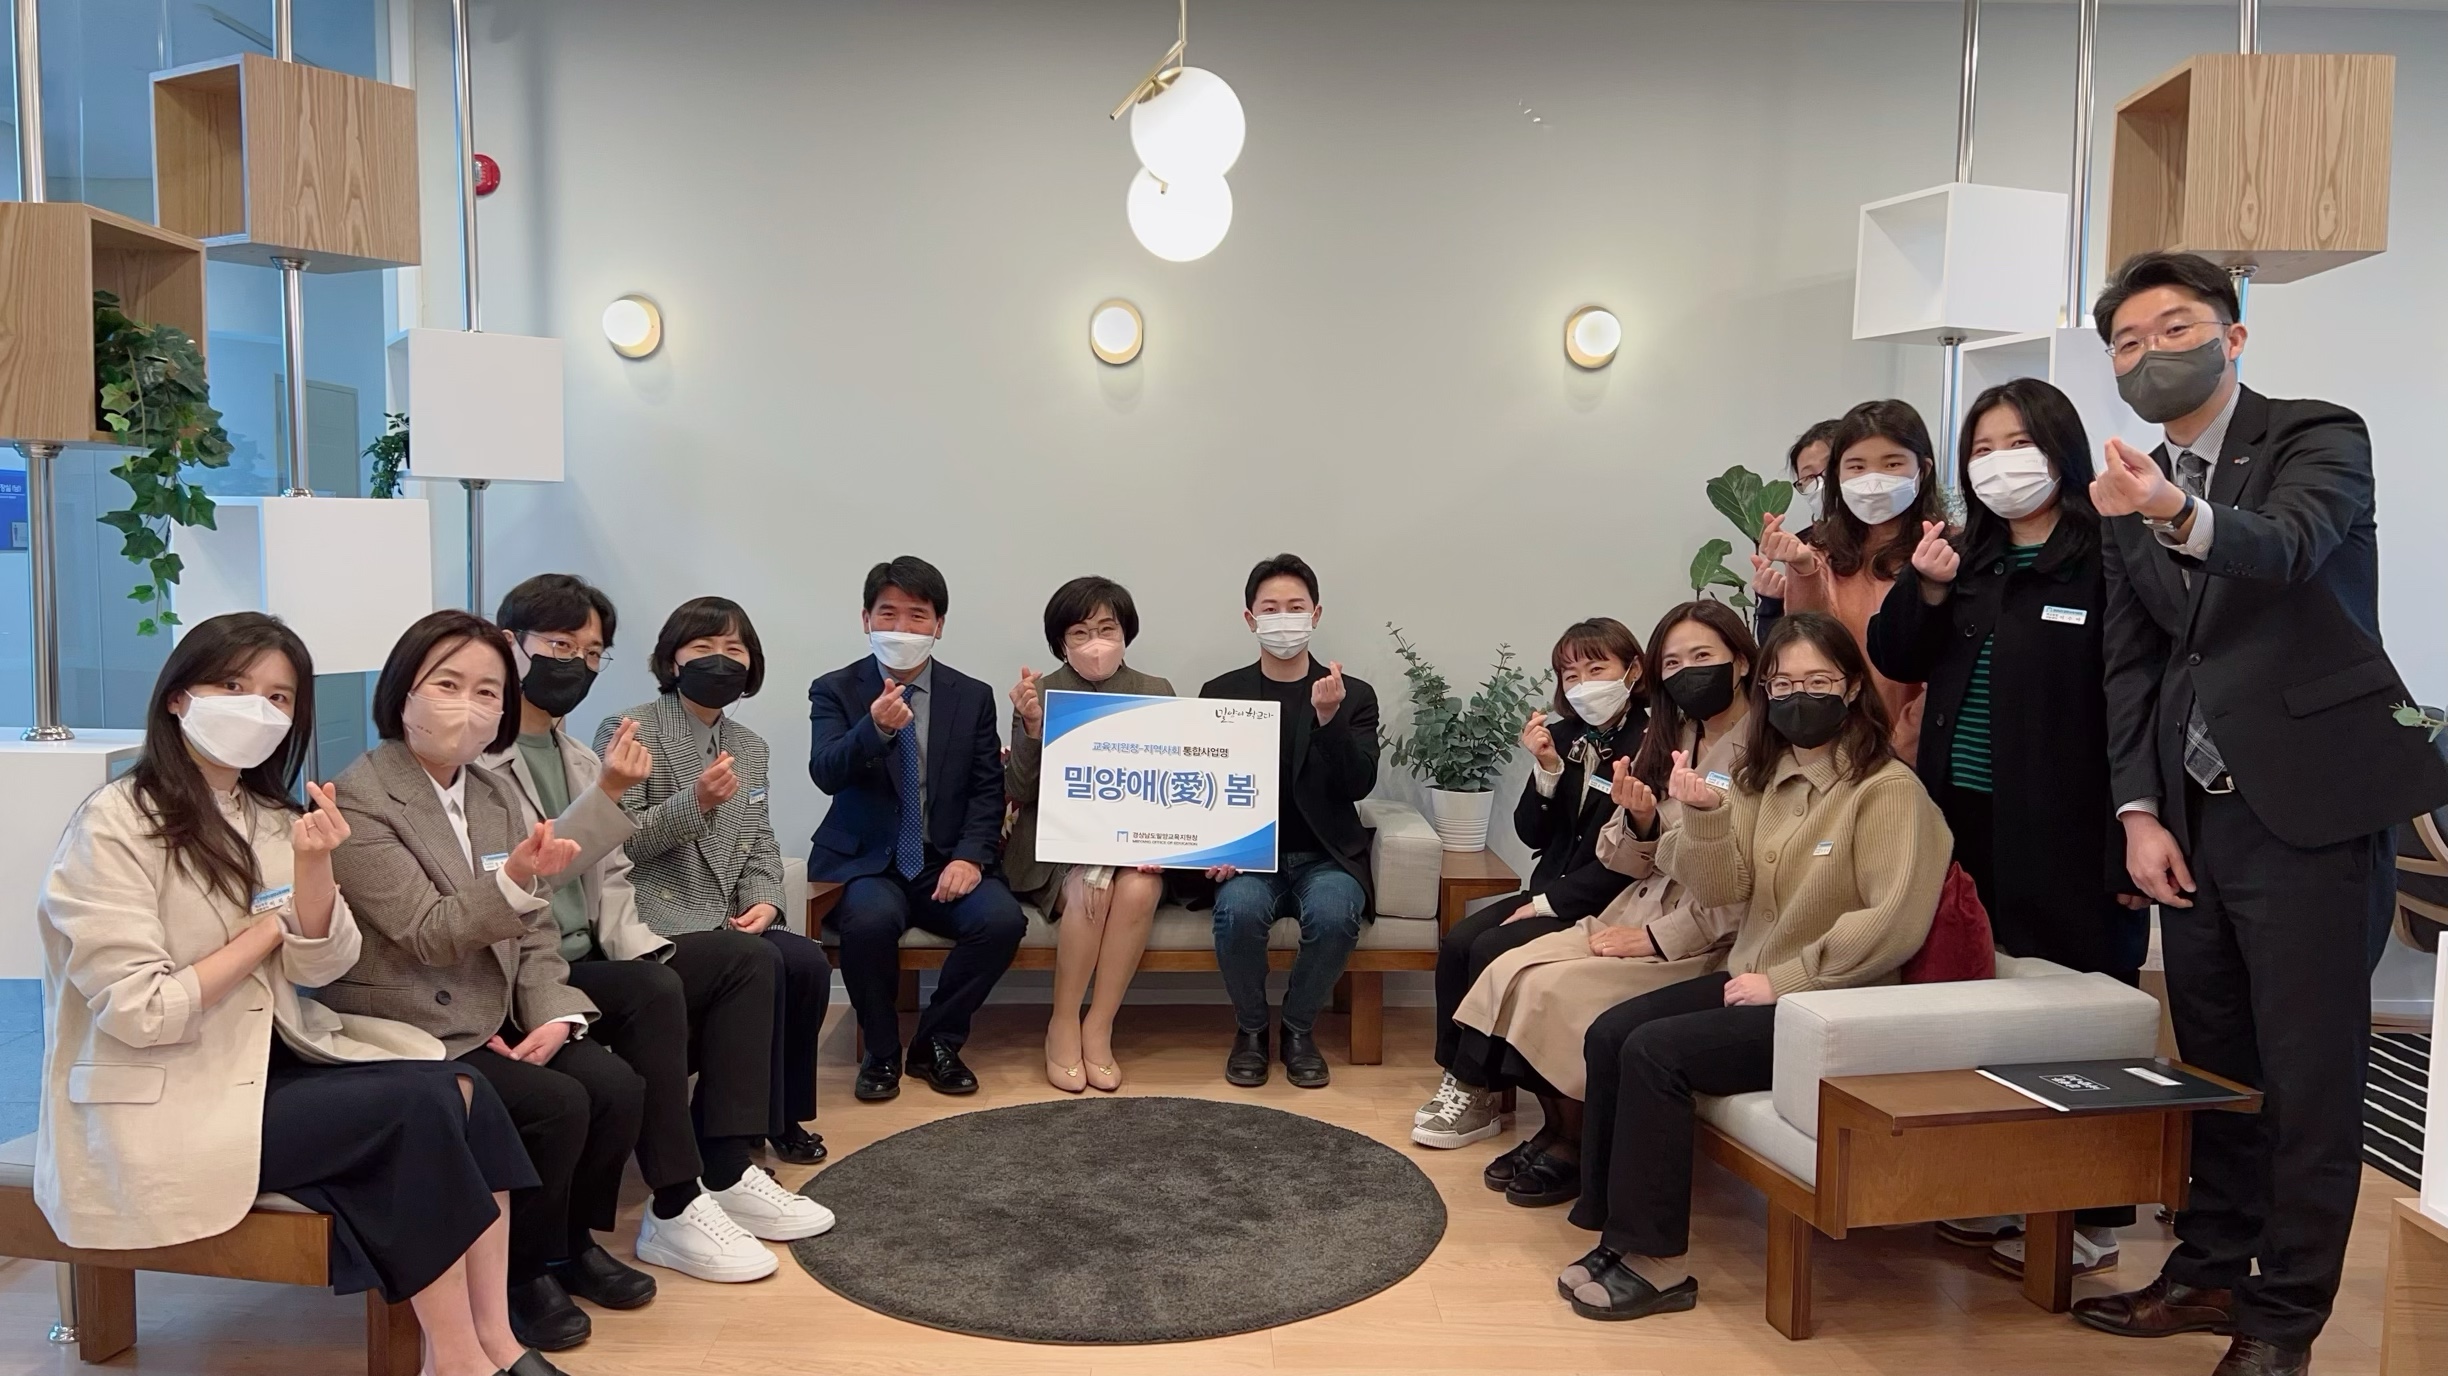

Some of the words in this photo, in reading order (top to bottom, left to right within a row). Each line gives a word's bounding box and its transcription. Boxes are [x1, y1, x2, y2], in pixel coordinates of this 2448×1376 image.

[1092, 741, 1181, 756] 교육지원청-지역사회
[1182, 745, 1229, 758] 통합사업명
[1064, 766, 1216, 809] 밀양애(愛)
[1224, 772, 1257, 808] 봄
